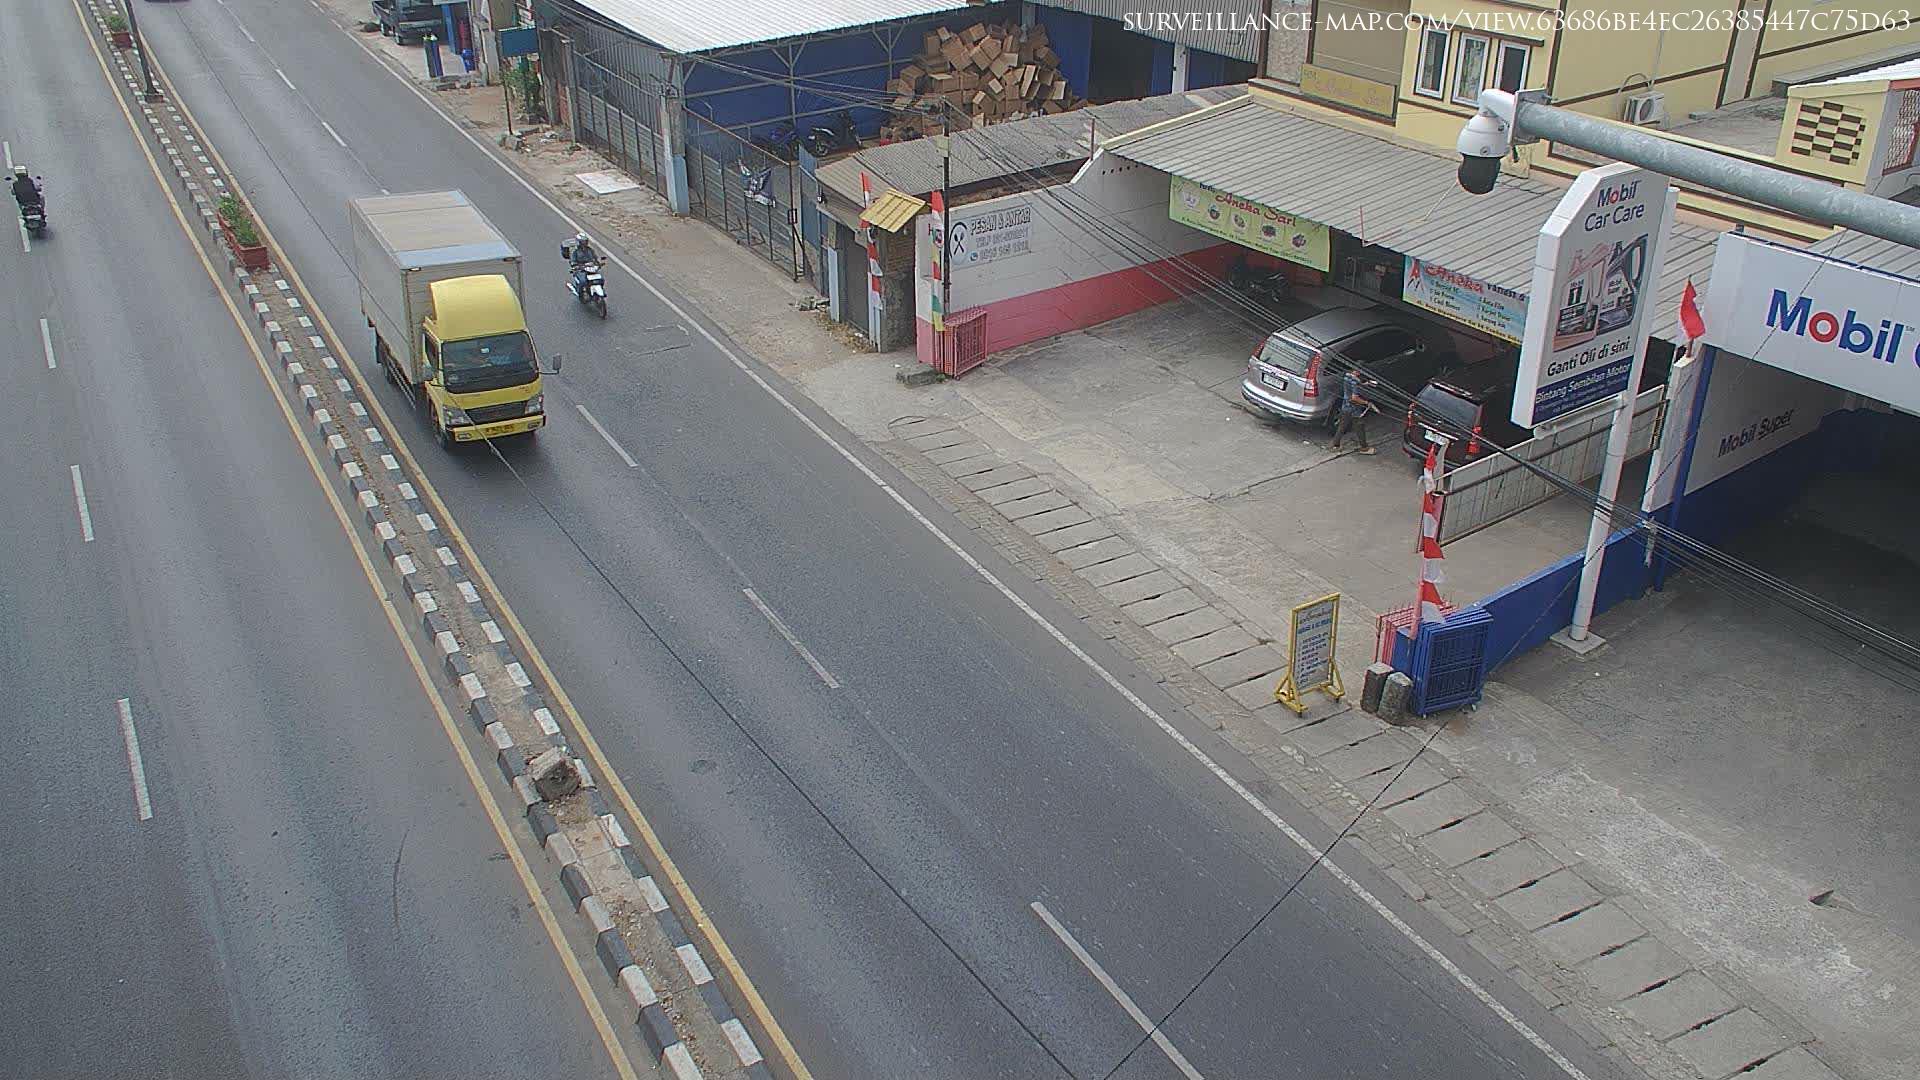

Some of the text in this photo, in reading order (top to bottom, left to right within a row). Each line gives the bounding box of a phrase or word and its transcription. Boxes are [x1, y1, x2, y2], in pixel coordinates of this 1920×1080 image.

[1215, 193, 1260, 216] Aneka
[1597, 180, 1638, 207] Mobil
[971, 214, 996, 235] PESAN
[1005, 207, 1031, 227] ANTAR
[1585, 204, 1644, 231] Car Care
[1765, 288, 1905, 363] Mobil
[1547, 336, 1630, 376] Ganti Oli di sini
[1606, 363, 1631, 378] Motor
[1719, 409, 1795, 457] Mobil Super
